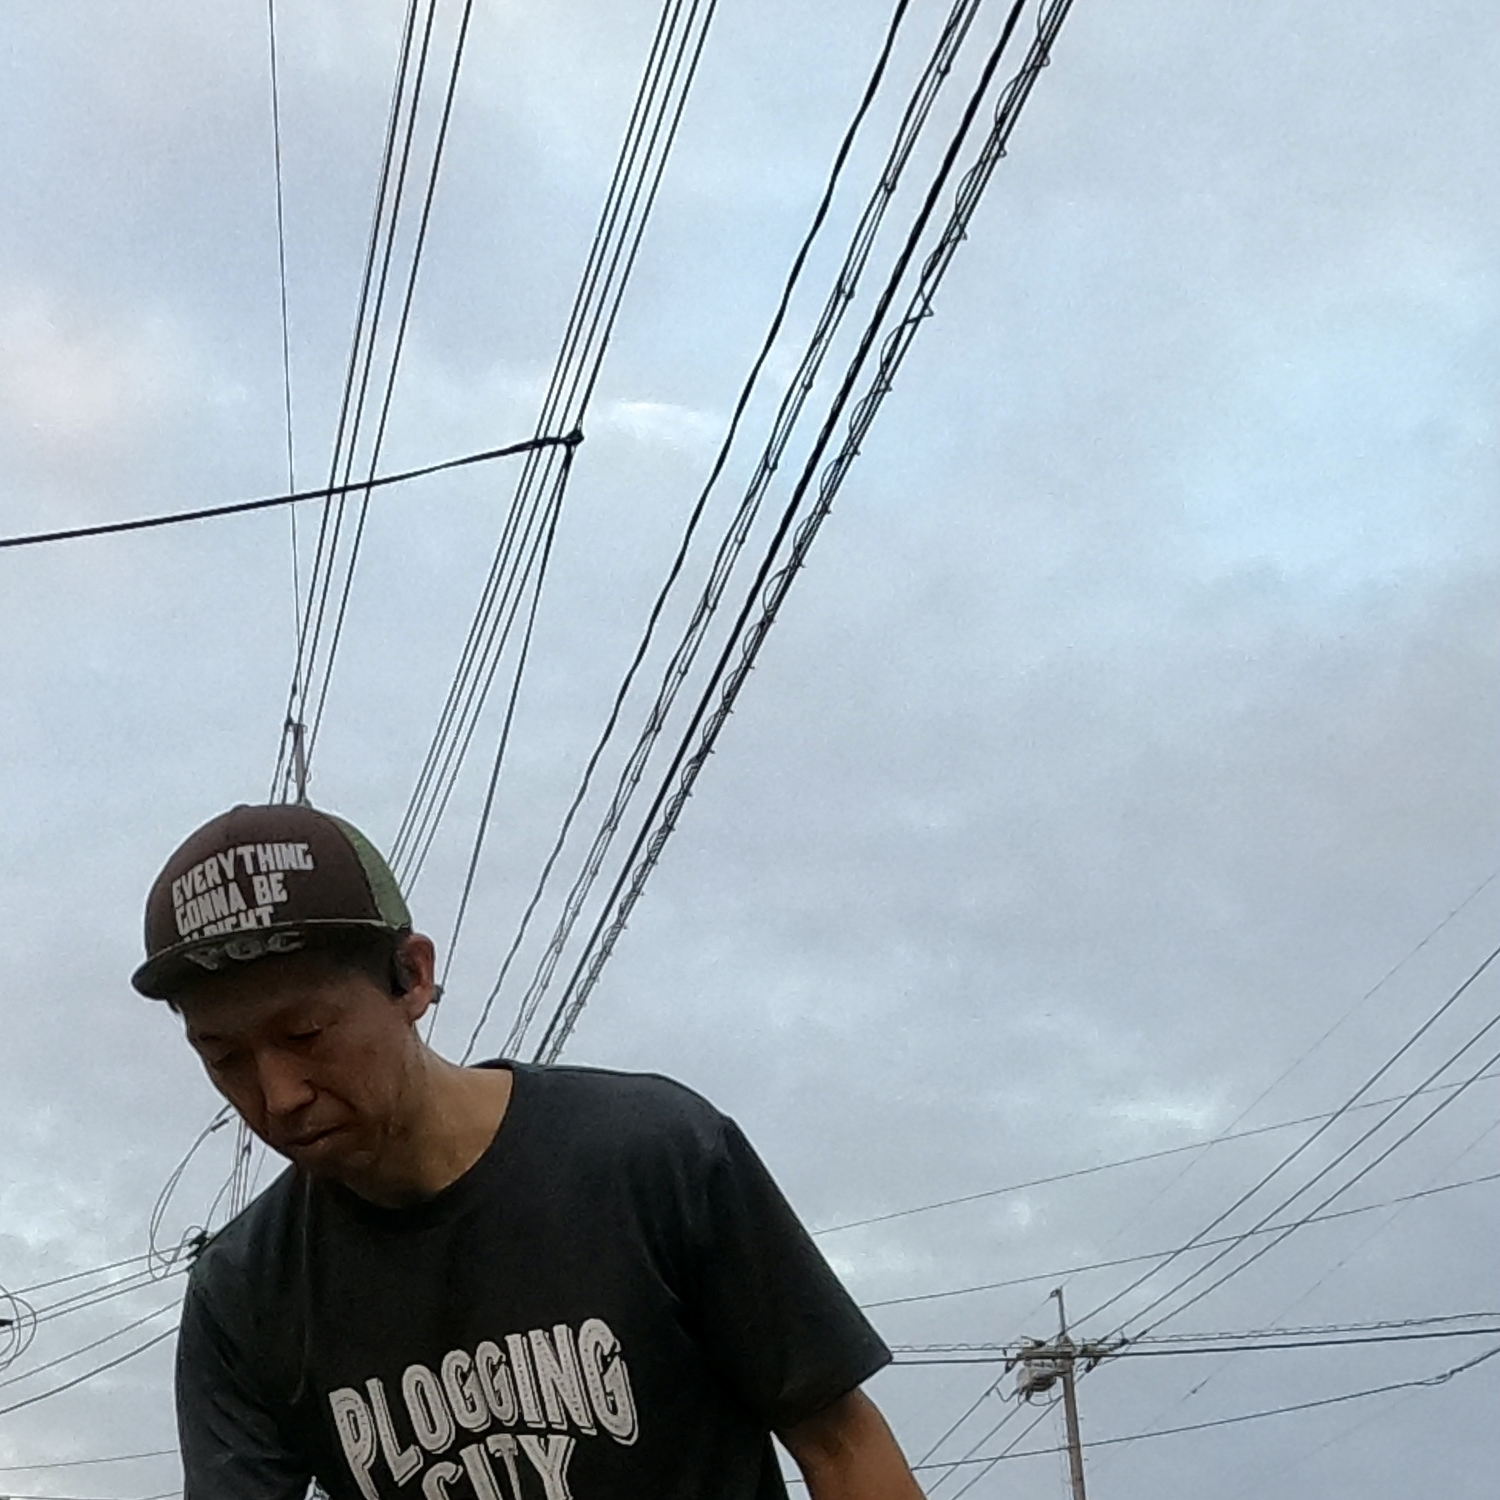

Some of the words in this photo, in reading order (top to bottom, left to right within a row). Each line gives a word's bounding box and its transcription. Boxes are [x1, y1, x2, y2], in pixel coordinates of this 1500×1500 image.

[171, 842, 315, 908] EVERYTHING
[174, 881, 248, 937] GONNA
[252, 872, 288, 906] BE
[183, 904, 275, 943] RIGHT
